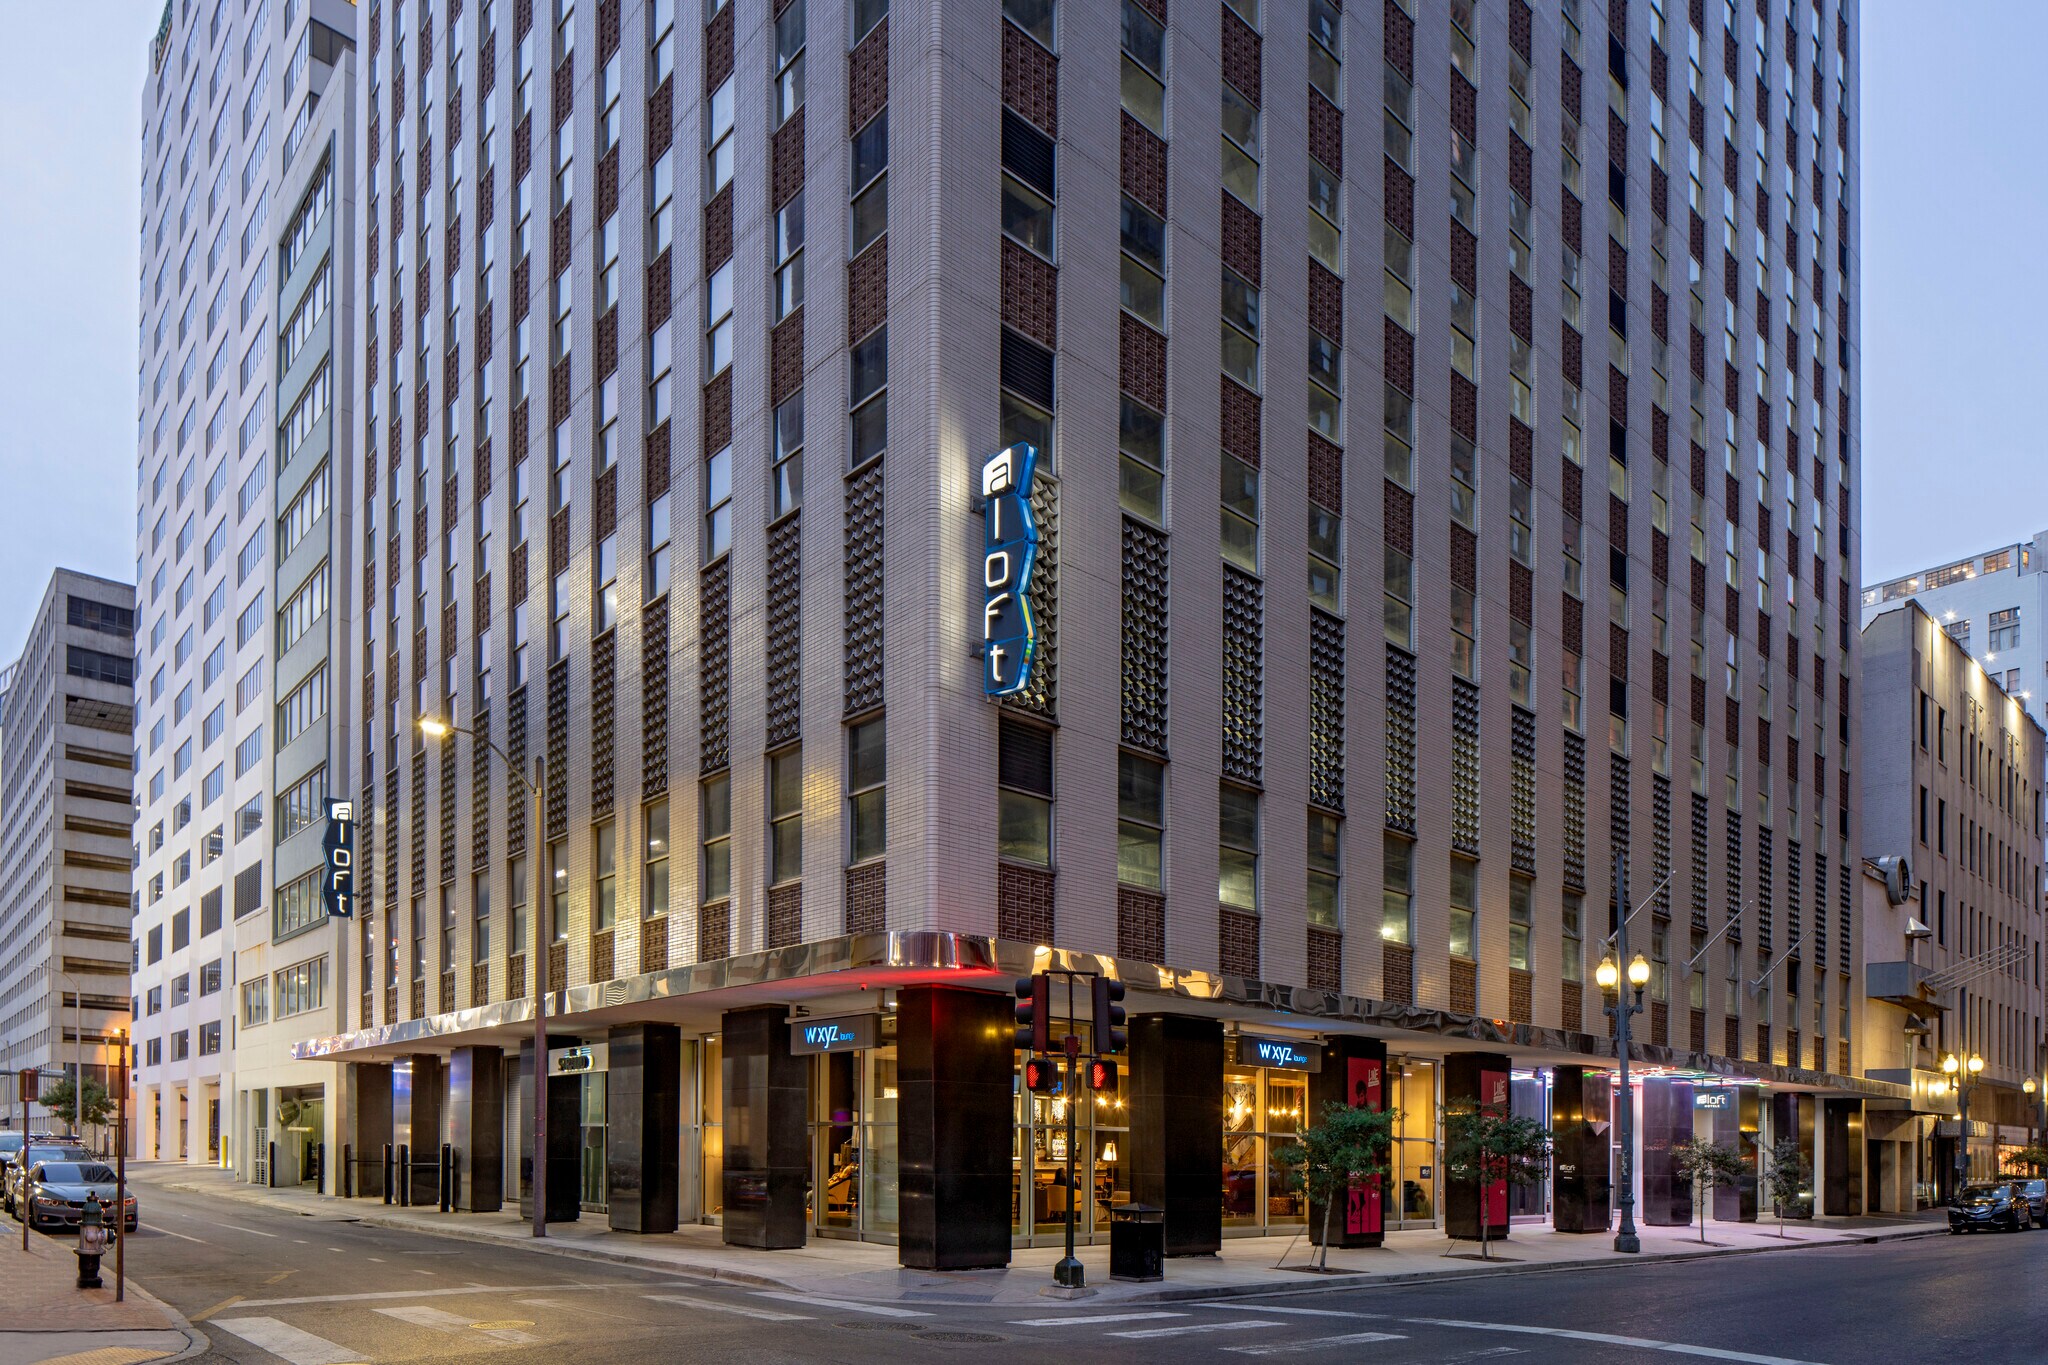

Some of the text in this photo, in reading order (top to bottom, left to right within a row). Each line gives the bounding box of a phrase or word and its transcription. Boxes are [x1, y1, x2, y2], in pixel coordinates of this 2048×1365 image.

[983, 448, 1012, 682] aloft
[332, 802, 352, 913] aloft
[1697, 1094, 1725, 1104] aloft
